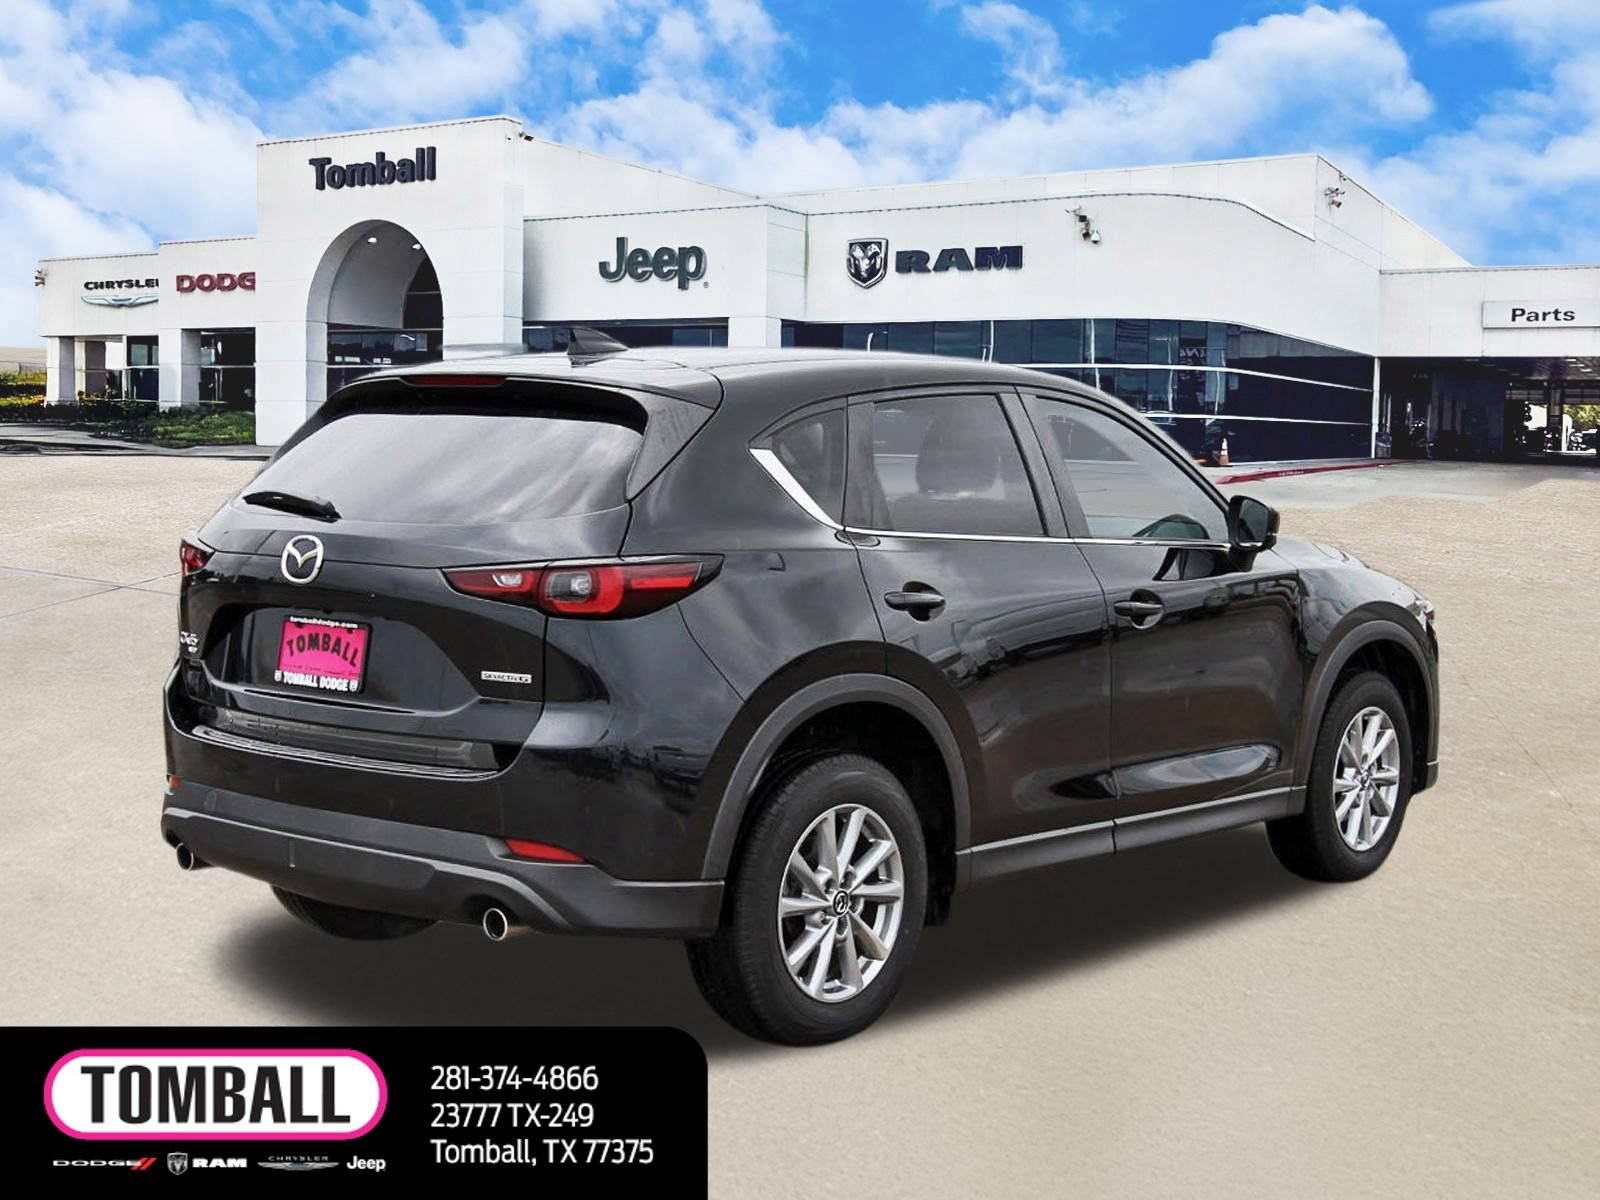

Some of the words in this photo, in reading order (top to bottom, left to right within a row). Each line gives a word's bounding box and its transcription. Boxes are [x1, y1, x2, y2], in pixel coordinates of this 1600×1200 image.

[309, 146, 437, 191] Tomball
[598, 236, 707, 290] Jeep
[895, 245, 1023, 274] RAM
[83, 278, 160, 291] CHRYSLE
[1511, 307, 1576, 324] Parts
[287, 632, 358, 668] TOMBALL
[283, 671, 318, 687] TOMBALL
[319, 675, 349, 691] DODGE
